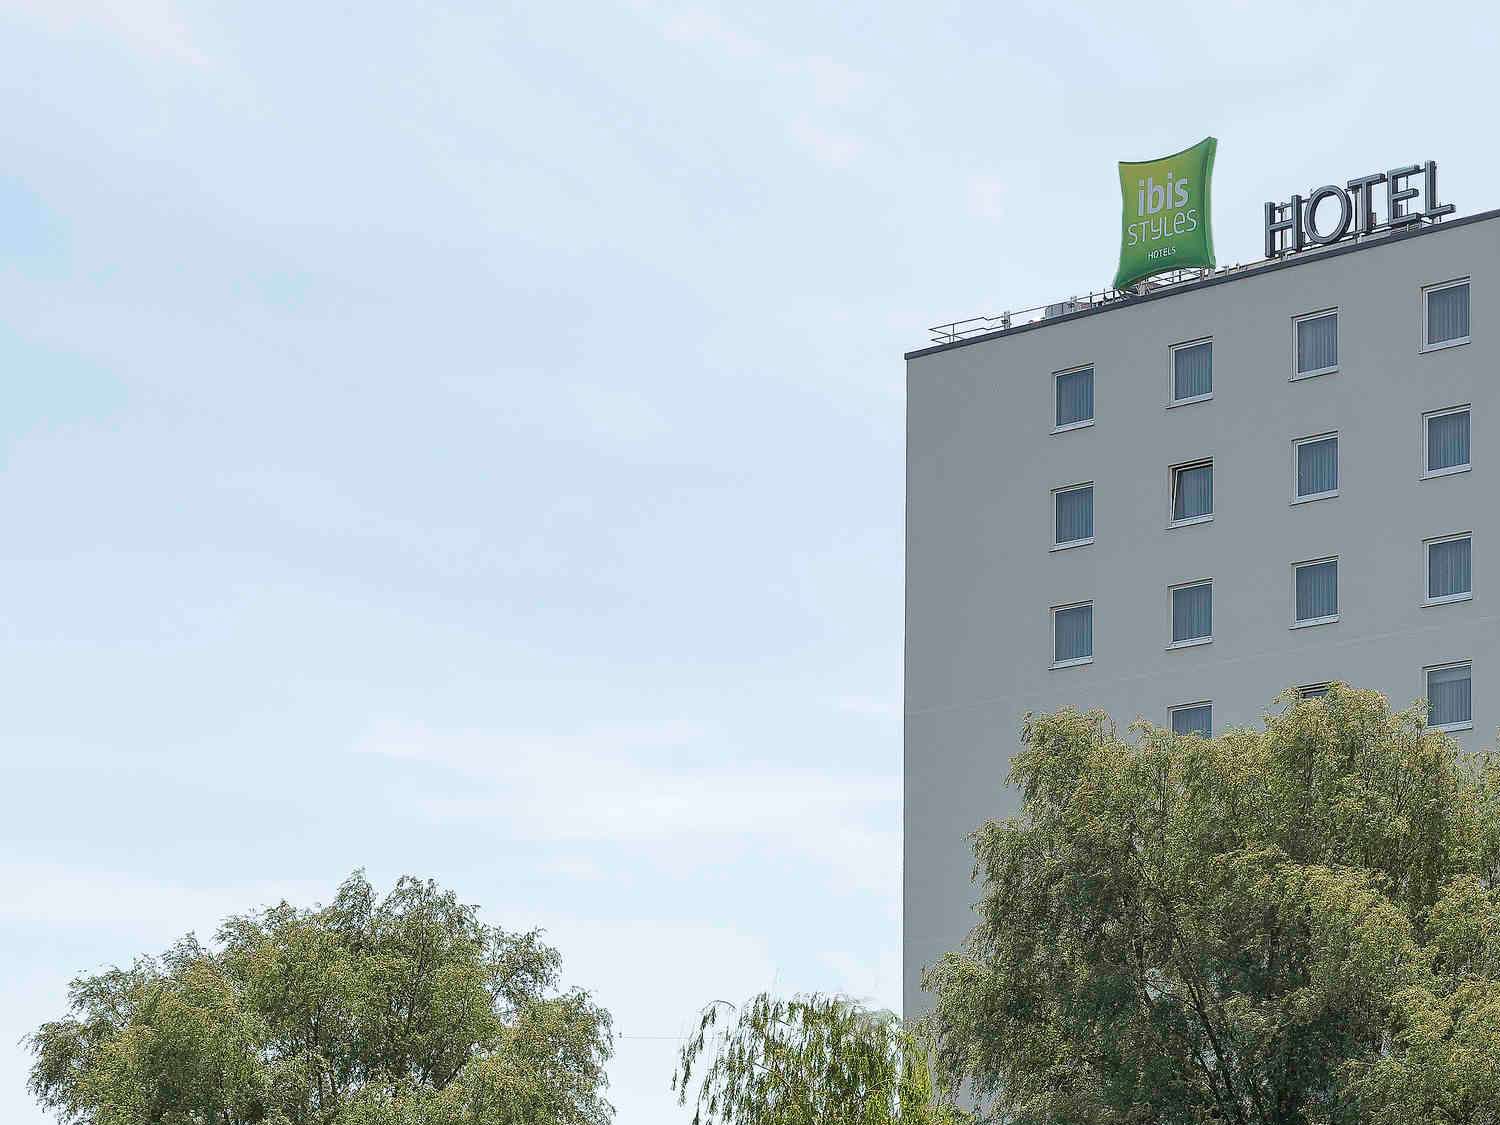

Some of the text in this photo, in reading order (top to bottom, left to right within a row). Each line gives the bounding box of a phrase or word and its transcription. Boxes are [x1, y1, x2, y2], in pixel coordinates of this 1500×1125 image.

[1137, 170, 1189, 217] ibis
[1264, 160, 1456, 258] HOTEL
[1146, 246, 1177, 260] HOTELS
